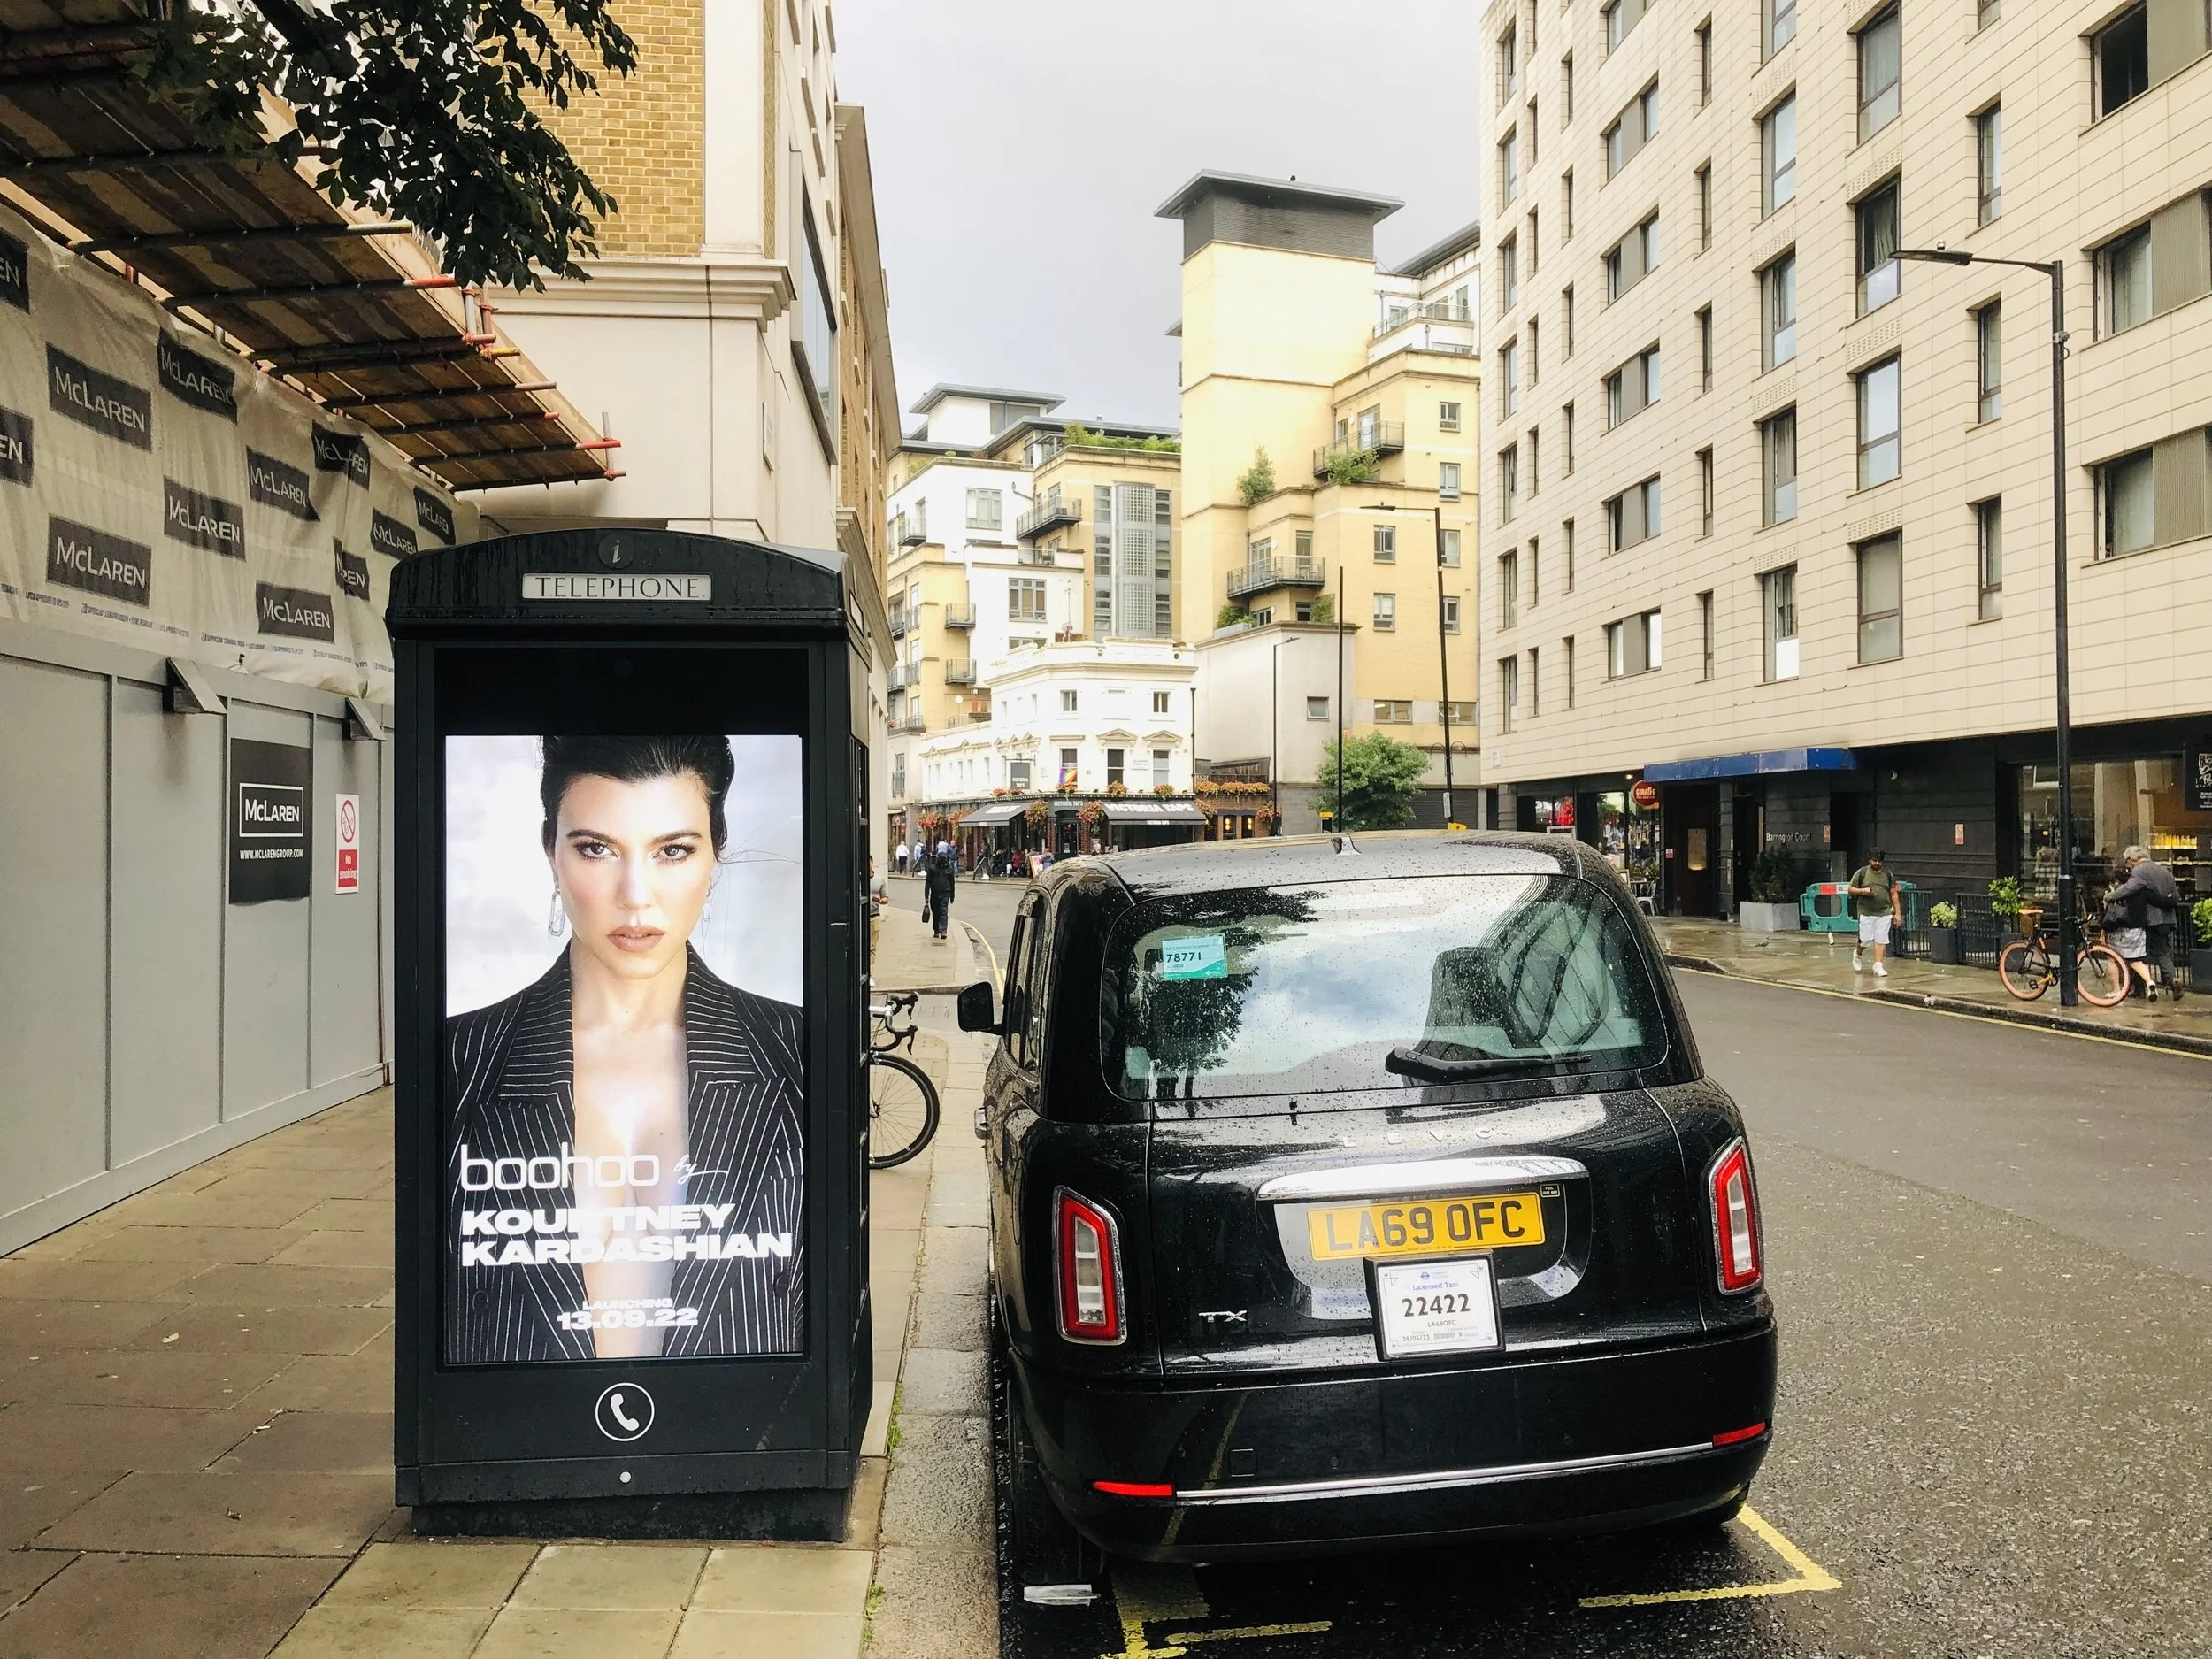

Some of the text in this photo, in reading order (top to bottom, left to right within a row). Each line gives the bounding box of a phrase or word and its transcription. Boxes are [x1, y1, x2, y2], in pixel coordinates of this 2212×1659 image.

[55, 366, 145, 432] McLAREN
[250, 465, 306, 508] McLAREN
[169, 495, 241, 544] McLAREN
[56, 536, 146, 588] McLAREN
[534, 577, 701, 598] TELEPHONE
[263, 597, 331, 629] McLAREN
[244, 799, 300, 822] McLAREN
[1162, 803, 1195, 812] TAPS
[1766, 832, 1811, 843] Barrington Court
[240, 849, 303, 860] WWW.MCLARENGROUP.COM
[344, 855, 352, 864] No
[1166, 951, 1202, 963] 78771
[460, 1142, 660, 1191] boohoo
[461, 1203, 736, 1236] KOURTNEY
[1326, 1200, 1525, 1251] LA69 OFC
[461, 1233, 793, 1267] KARDASHIAN
[582, 1297, 673, 1310] LAUNCHING
[1402, 1293, 1471, 1317] 22422
[557, 1308, 699, 1331] 13.09.22
[1199, 1310, 1248, 1323] TX
